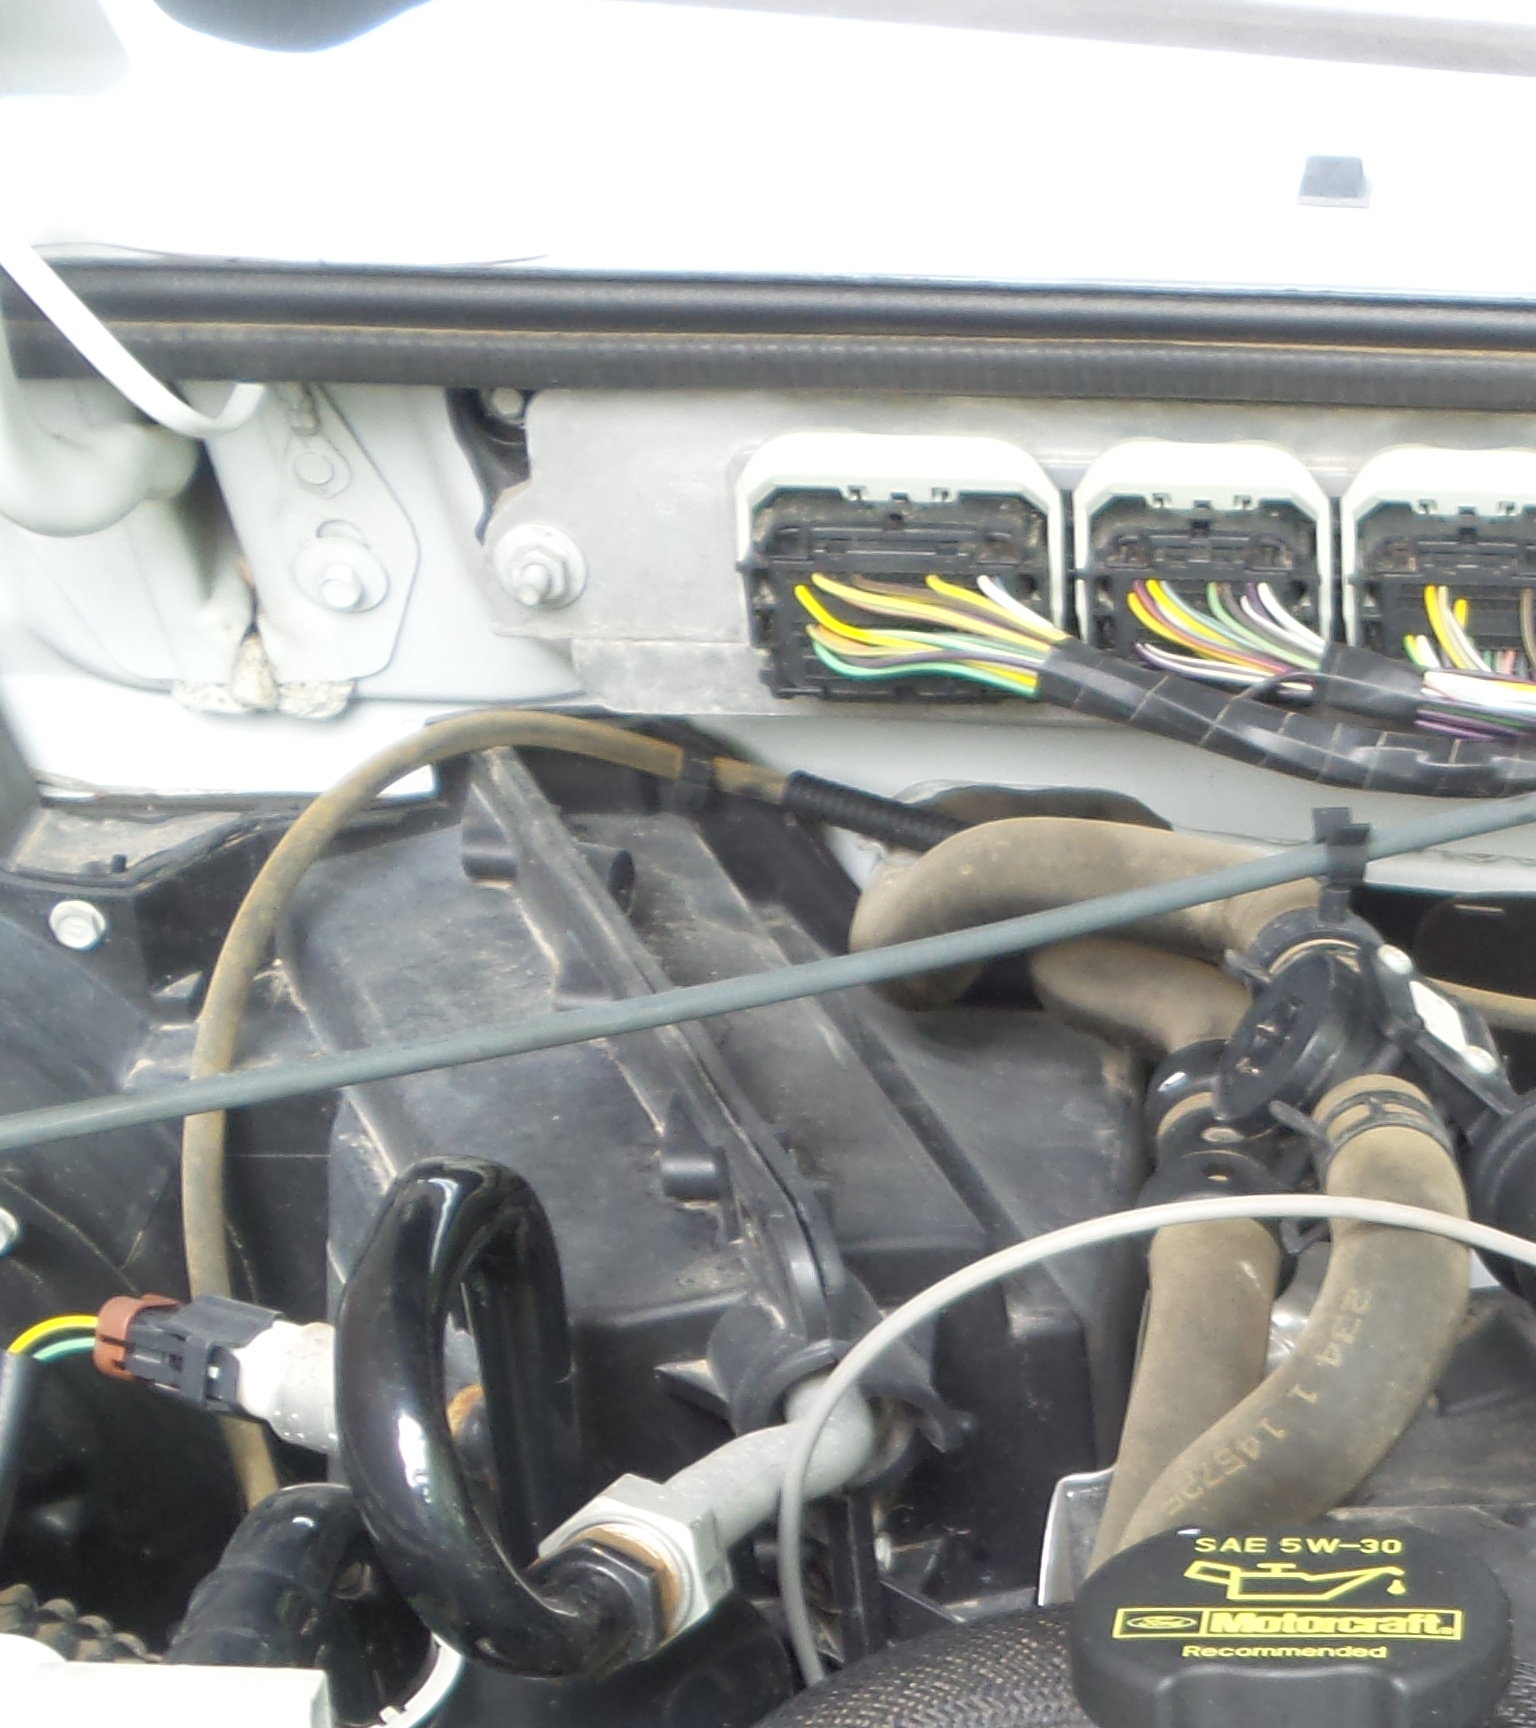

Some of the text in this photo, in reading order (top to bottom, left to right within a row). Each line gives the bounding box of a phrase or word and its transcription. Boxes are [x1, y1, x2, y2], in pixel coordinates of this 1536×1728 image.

[1194, 1536, 1403, 1554] SAE 5W-30
[1209, 1611, 1440, 1635] Motorcraft
[1182, 1645, 1387, 1658] Recommended
